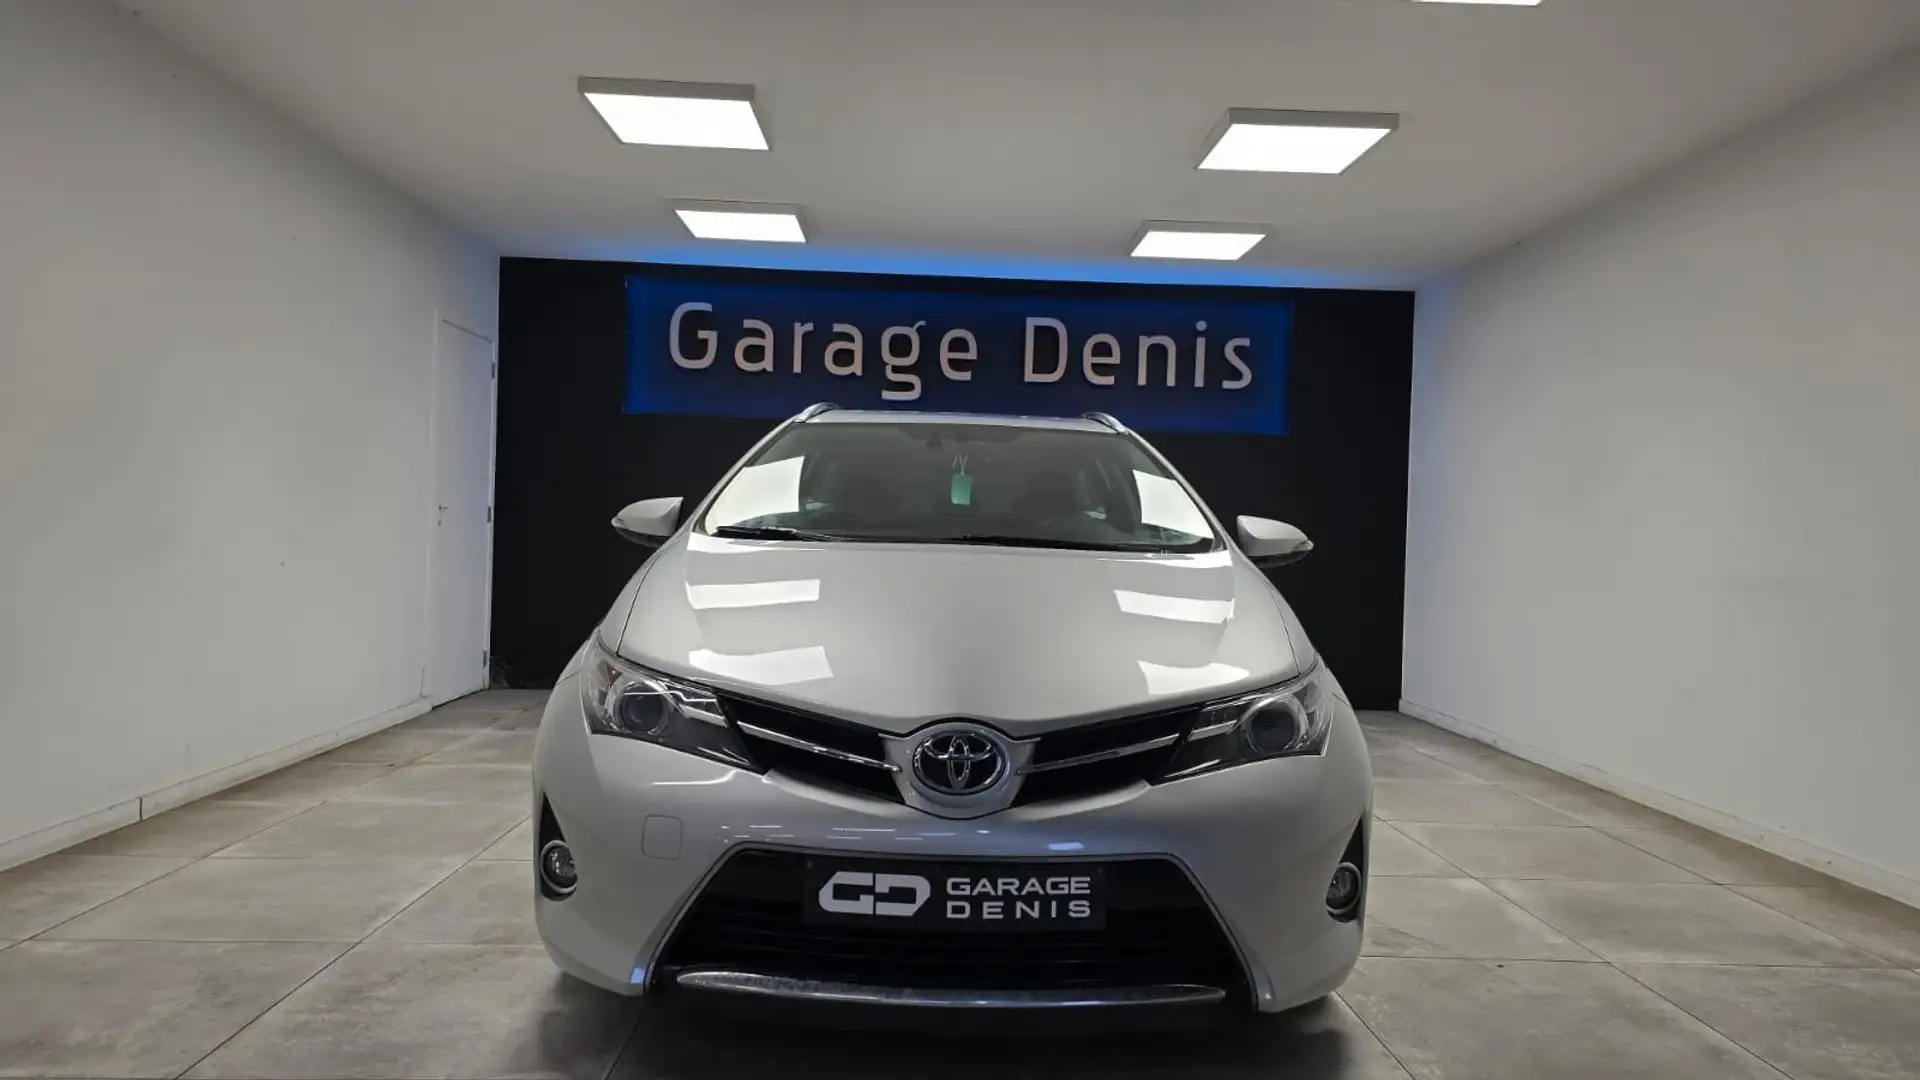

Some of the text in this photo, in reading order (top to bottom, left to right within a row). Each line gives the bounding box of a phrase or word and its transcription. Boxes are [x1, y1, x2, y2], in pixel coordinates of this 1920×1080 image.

[668, 301, 1253, 401] Garage Denis
[946, 876, 1091, 896] GARAGE
[946, 900, 1091, 919] DENIS
